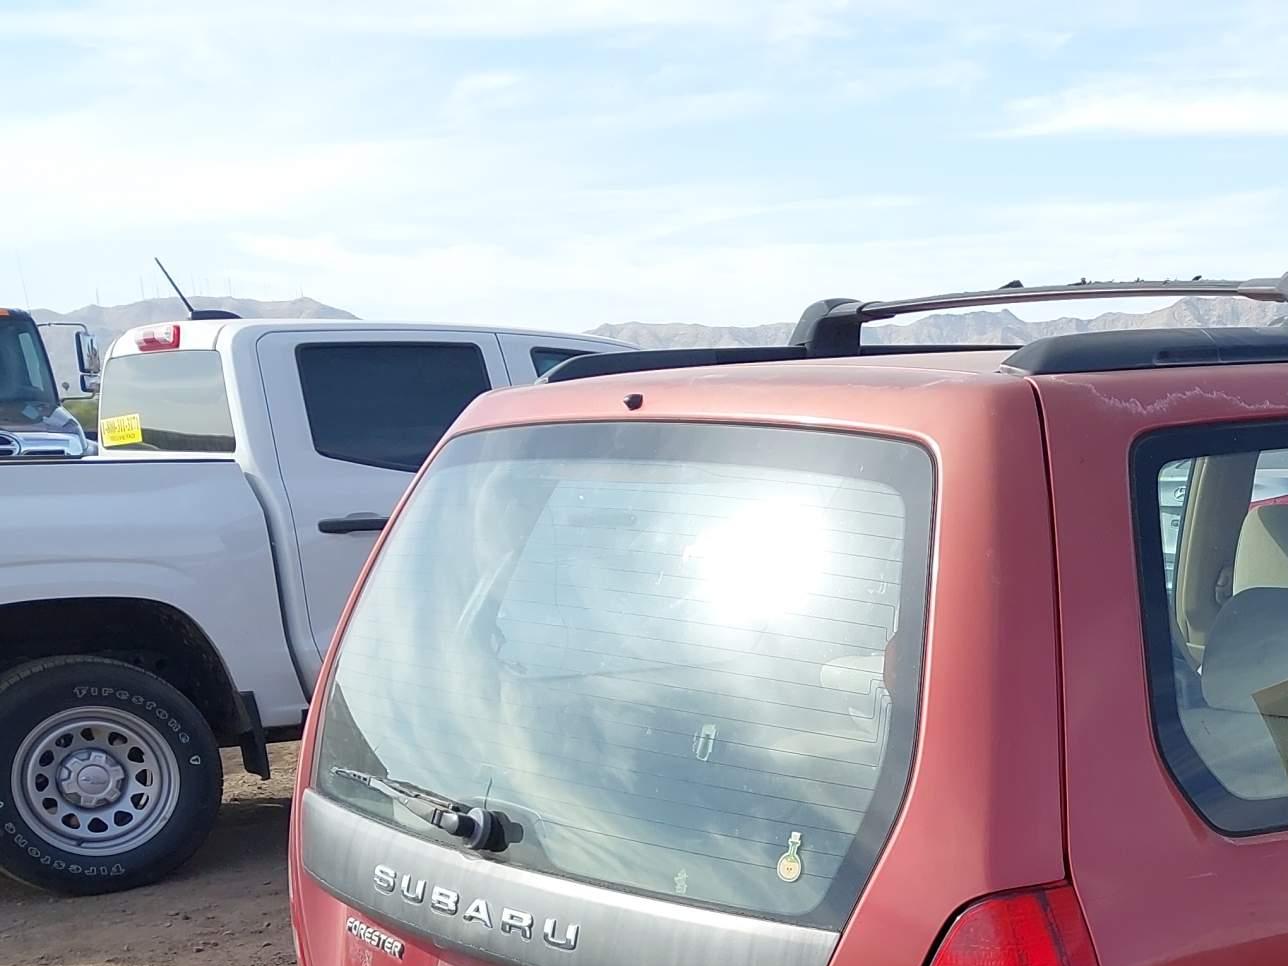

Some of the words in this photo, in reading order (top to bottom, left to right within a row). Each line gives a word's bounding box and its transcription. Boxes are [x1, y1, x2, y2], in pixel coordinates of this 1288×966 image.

[73, 686, 191, 744] Firestone
[4, 821, 125, 876] Firestone
[373, 863, 581, 952] SUBARU
[346, 917, 405, 960] FORESTER
